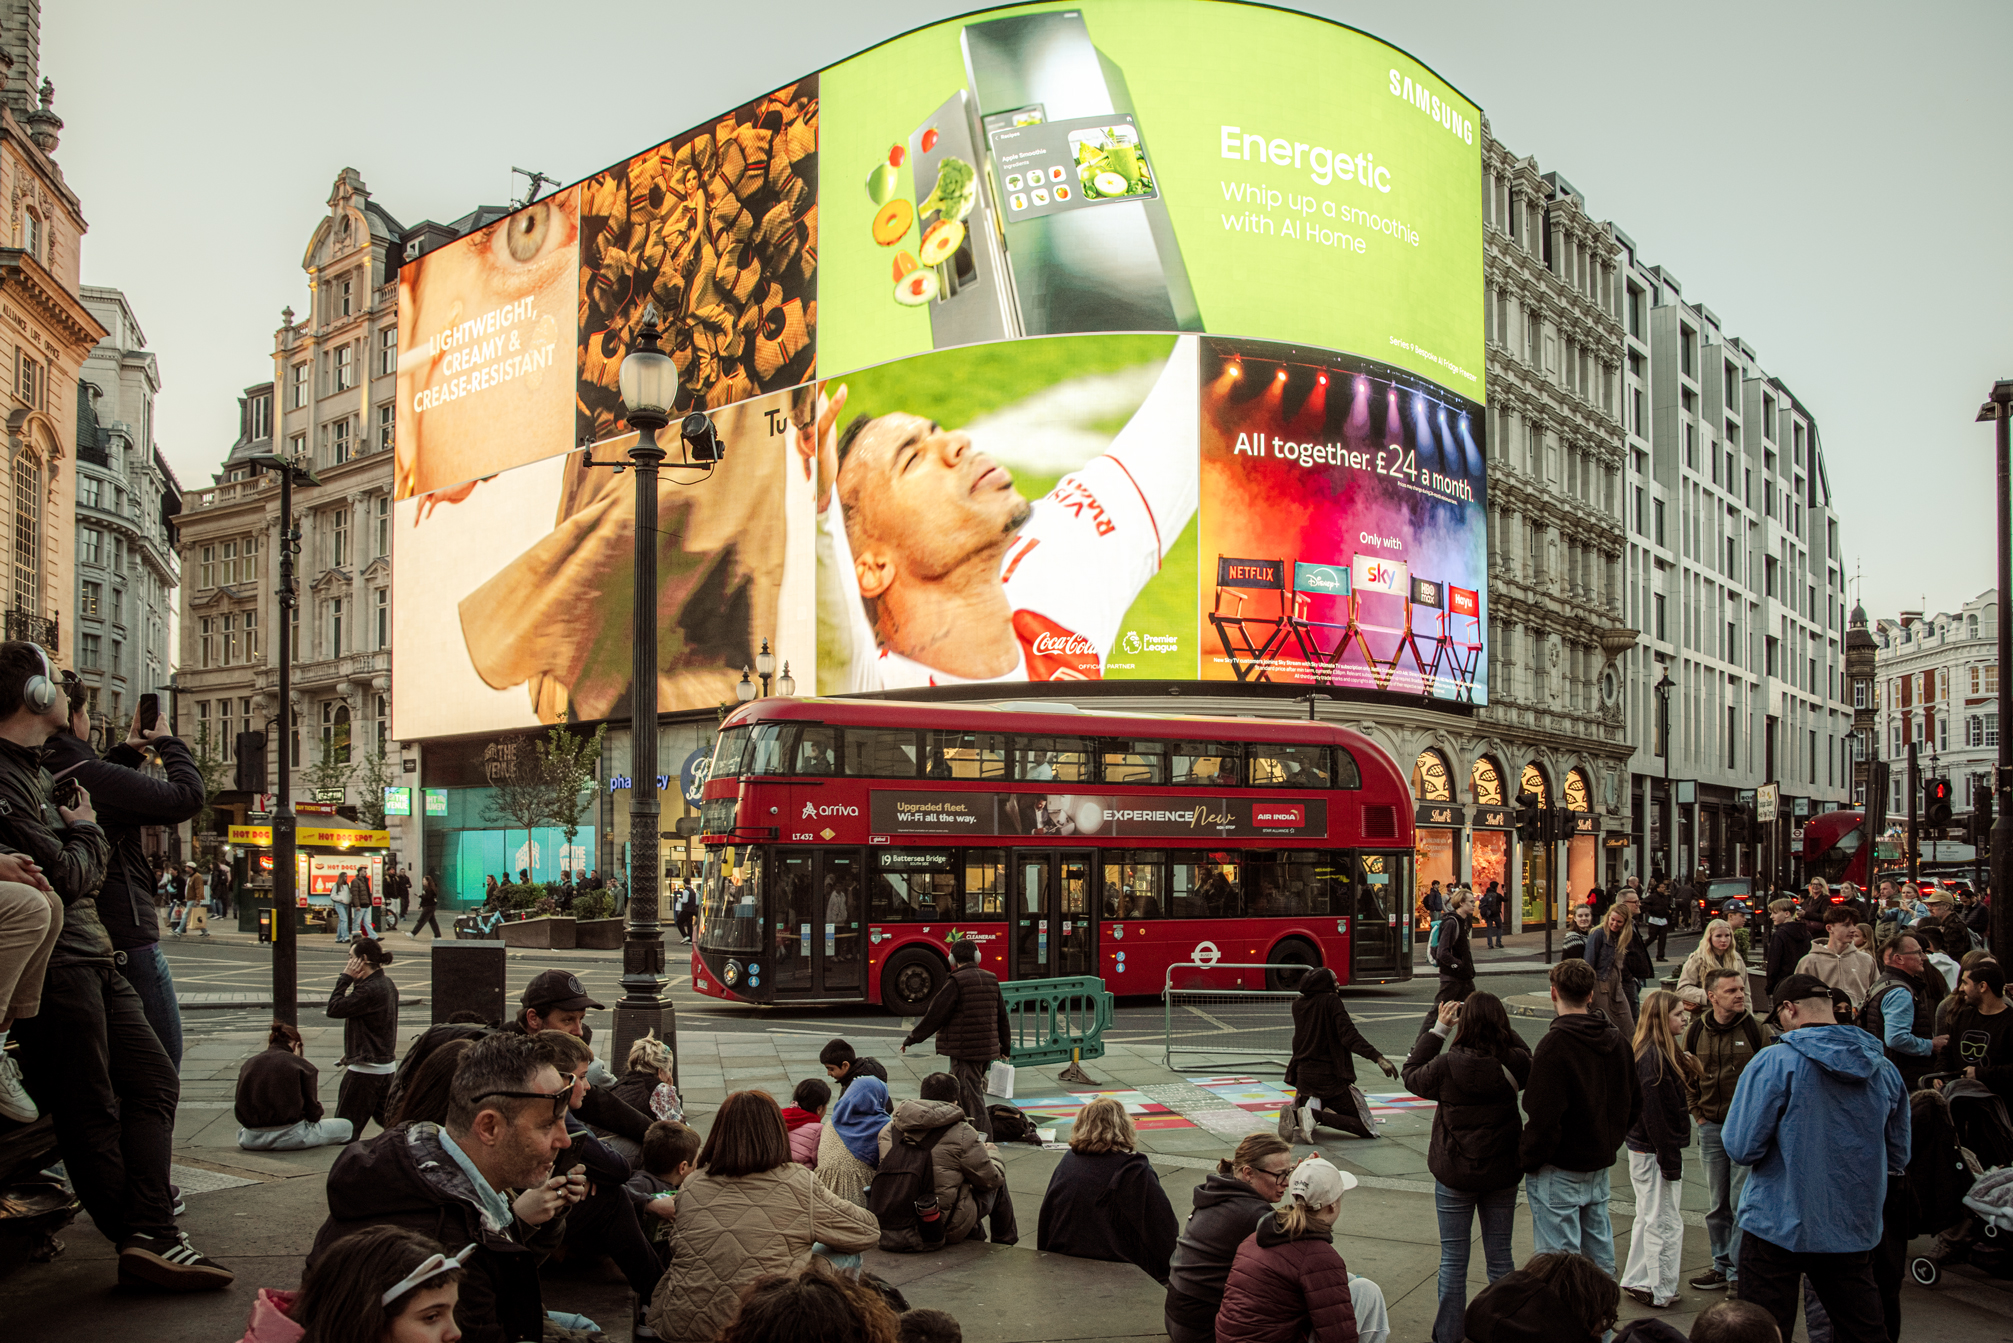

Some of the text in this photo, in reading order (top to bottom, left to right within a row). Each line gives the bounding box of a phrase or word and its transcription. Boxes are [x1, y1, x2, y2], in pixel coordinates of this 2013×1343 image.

[1389, 68, 1473, 145] SAMSUNG
[1002, 149, 1046, 162] Apple Smoothie
[1221, 125, 1391, 193] Energetic
[1221, 181, 1419, 246] Whip up a smoothie
[1221, 212, 1366, 253] with AI Home
[429, 296, 538, 356] LIGHTWEIGHT,
[442, 330, 521, 377] CREAMY &
[1389, 336, 1409, 350] Series
[1415, 345, 1437, 362] Bespoke
[1444, 359, 1458, 374] Fridge
[1459, 367, 1477, 382] Freezer
[413, 344, 555, 413] CREASE-RESISTANT
[764, 409, 788, 438] Tu
[1234, 433, 1474, 502] All together. £24 a month.
[1360, 531, 1402, 550] Only with
[1229, 565, 1274, 582] NETFLIX
[1368, 563, 1395, 589] sky
[1421, 582, 1435, 596] HBO
[1421, 594, 1435, 604] max
[1455, 593, 1472, 609] Hayu
[1143, 634, 1178, 643] Premier
[1143, 643, 1178, 653] League
[610, 774, 669, 792] phacy
[819, 803, 859, 816] arriva
[897, 802, 968, 813] Upgraded fleet.
[897, 813, 977, 824] Wi-Fi all the way.
[1103, 805, 1235, 828] EXPERIENCE New
[318, 832, 334, 841] HOT
[337, 834, 352, 842] DOG
[354, 834, 373, 842] SPOT
[792, 833, 814, 841] LT432
[570, 846, 586, 858] THE
[881, 854, 892, 866] 19
[926, 855, 946, 864] Bridge
[559, 858, 586, 870] VENUE
